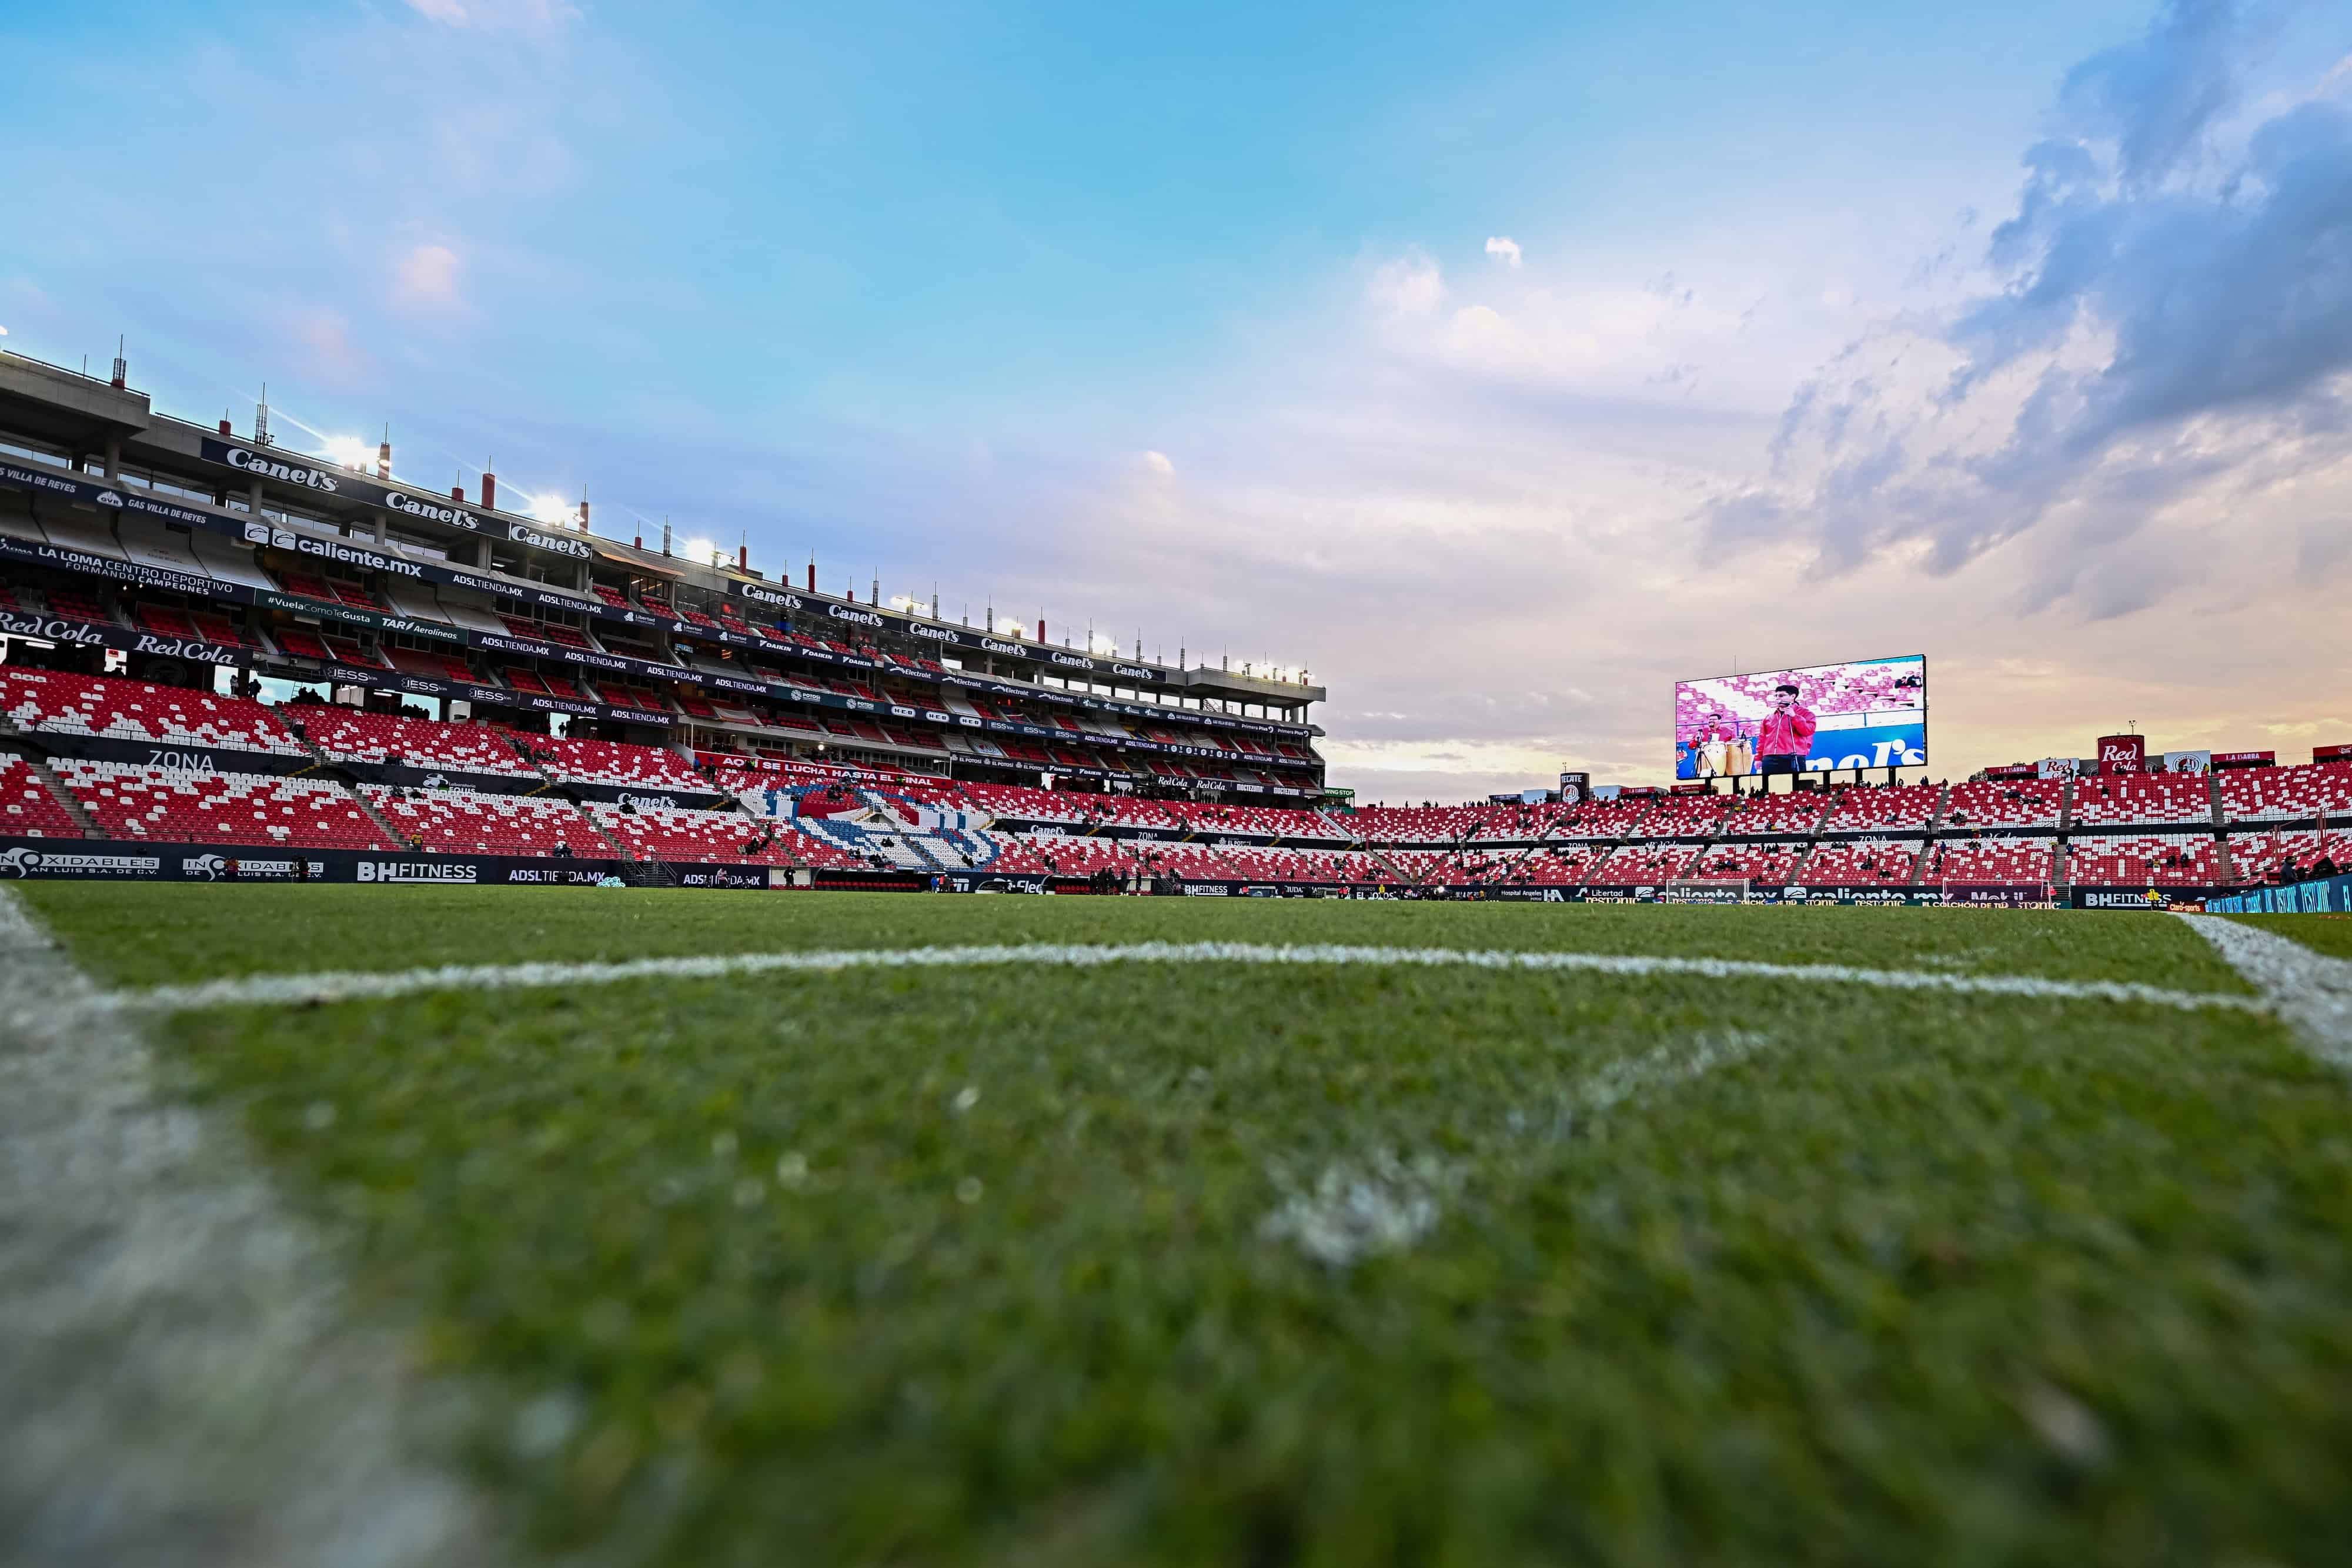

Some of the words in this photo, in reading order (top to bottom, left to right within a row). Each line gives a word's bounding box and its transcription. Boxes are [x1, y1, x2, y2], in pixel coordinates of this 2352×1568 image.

[226, 449, 338, 492] Canel's
[8, 469, 32, 482] VILLA
[34, 477, 47, 486] DE
[48, 479, 76, 493] REYES
[128, 499, 145, 509] GAS
[146, 503, 168, 515] VILLA
[170, 509, 181, 518] DE
[181, 512, 206, 523] REYES
[386, 492, 478, 529] Canel's
[510, 526, 591, 559] Canel's
[298, 540, 422, 577] caliente.mx
[39, 547, 57, 558] LA
[61, 550, 103, 567] LOMA
[106, 560, 159, 578] CENTRO
[163, 572, 233, 593] DEPORTIVO
[66, 561, 135, 581] FORMANDO
[139, 576, 209, 595] CAMPEONES
[453, 574, 523, 597] ADSLTIENDA.MX
[539, 594, 602, 614] ADSLTIENDA.MX
[742, 584, 802, 609] Canel's
[268, 597, 370, 623] #VuelaComoTeGusta
[828, 604, 883, 627] Canel's
[382, 618, 406, 629] TAR
[413, 625, 457, 640] Aerolíneas
[910, 623, 960, 643] Canel's
[481, 637, 549, 656] ADSLTIENDA.MX
[766, 642, 791, 652] DAIKIN
[808, 651, 833, 660] DAIKIN
[981, 638, 1027, 656] Canel's
[564, 651, 626, 669] ADSLTIENDA.MX
[848, 658, 871, 667] DAIKIN
[1051, 652, 1094, 669] Canel's
[647, 666, 702, 683] ADSLTIENDA.MX
[904, 668, 932, 679] Electrolit
[1113, 663, 1152, 680] Canel's
[716, 678, 766, 693] ADSLTIENDA.MX
[957, 678, 982, 688] Electrolit
[1005, 687, 1028, 696] Electrolit
[533, 698, 596, 715] ADSLTIENDA.MX
[1051, 694, 1074, 703] Electrolit
[611, 710, 669, 725] ADSLTIENDA.MX
[148, 750, 213, 770] ZONA
[2102, 743, 2139, 762] Red
[723, 757, 759, 767] AQÍ
[763, 761, 781, 770] SE
[785, 764, 827, 775] LUCHA
[832, 770, 877, 780] HASTA
[2046, 760, 2072, 772] Red
[1561, 775, 1582, 783] TECATE
[1237, 784, 1263, 793] MOCTEZUMA
[617, 793, 676, 809] Canel's
[1030, 825, 1065, 836] Canel's
[188, 858, 321, 871] INOIDABS
[509, 870, 605, 882] ADSLTIEDA.MX
